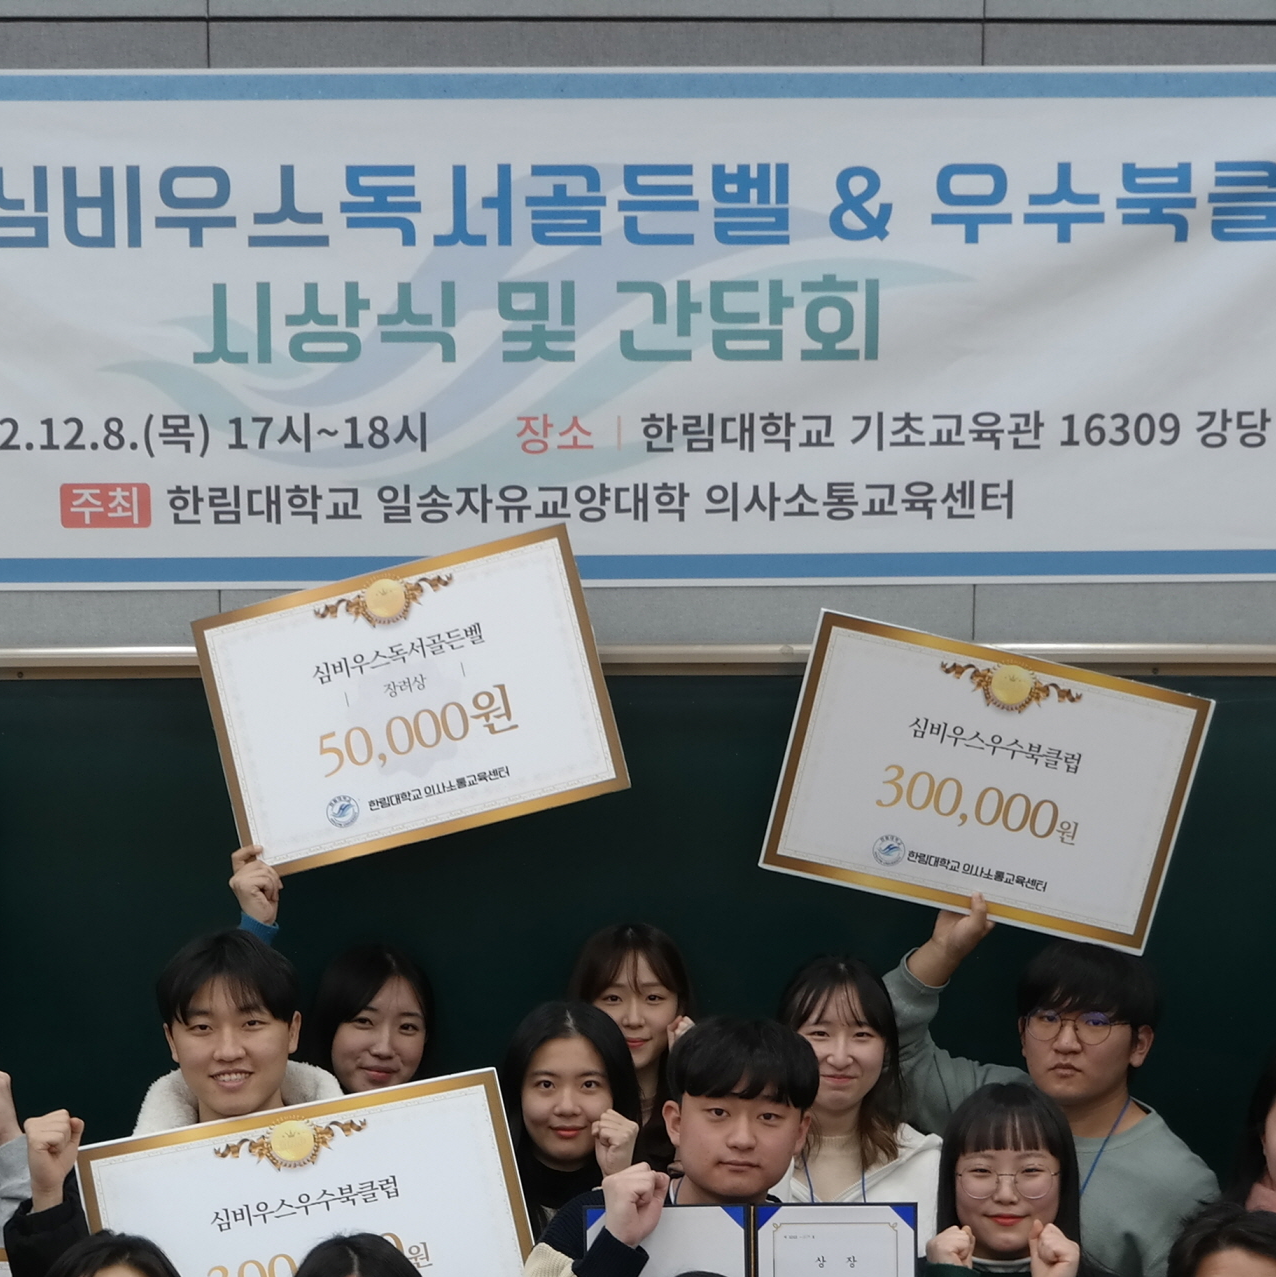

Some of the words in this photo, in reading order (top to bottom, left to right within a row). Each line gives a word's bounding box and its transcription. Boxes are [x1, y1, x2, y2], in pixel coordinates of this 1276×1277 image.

[828, 165, 894, 243] &
[192, 281, 457, 364] 시상식
[497, 279, 577, 362] 및
[616, 273, 880, 362] 간담회
[226, 412, 429, 454] 17시~18시
[515, 414, 595, 455] 장소
[640, 411, 835, 453] 한림대학교
[849, 409, 1045, 452] 기초교육관
[1059, 412, 1181, 447] 16309
[1194, 407, 1271, 451] 강당
[69, 485, 141, 524] 주최
[166, 483, 363, 526] 한림대학교
[377, 481, 690, 525] 일송자유교양대학
[704, 479, 1016, 523] 의사소통교육센터
[312, 621, 486, 686] 심비우스독서골든벨
[383, 673, 427, 699] 장려상
[318, 683, 519, 778] 50,000원
[908, 716, 1083, 775] 심비우스우수북클럽
[368, 788, 423, 812] 한림대학교
[424, 765, 511, 799] 의사소통교육센터
[875, 764, 1079, 847] 300,000원
[906, 850, 960, 873] 한림대학교
[962, 862, 1048, 892] 의사소통교육센터
[209, 1174, 401, 1233] 심비우스우수북클럽
